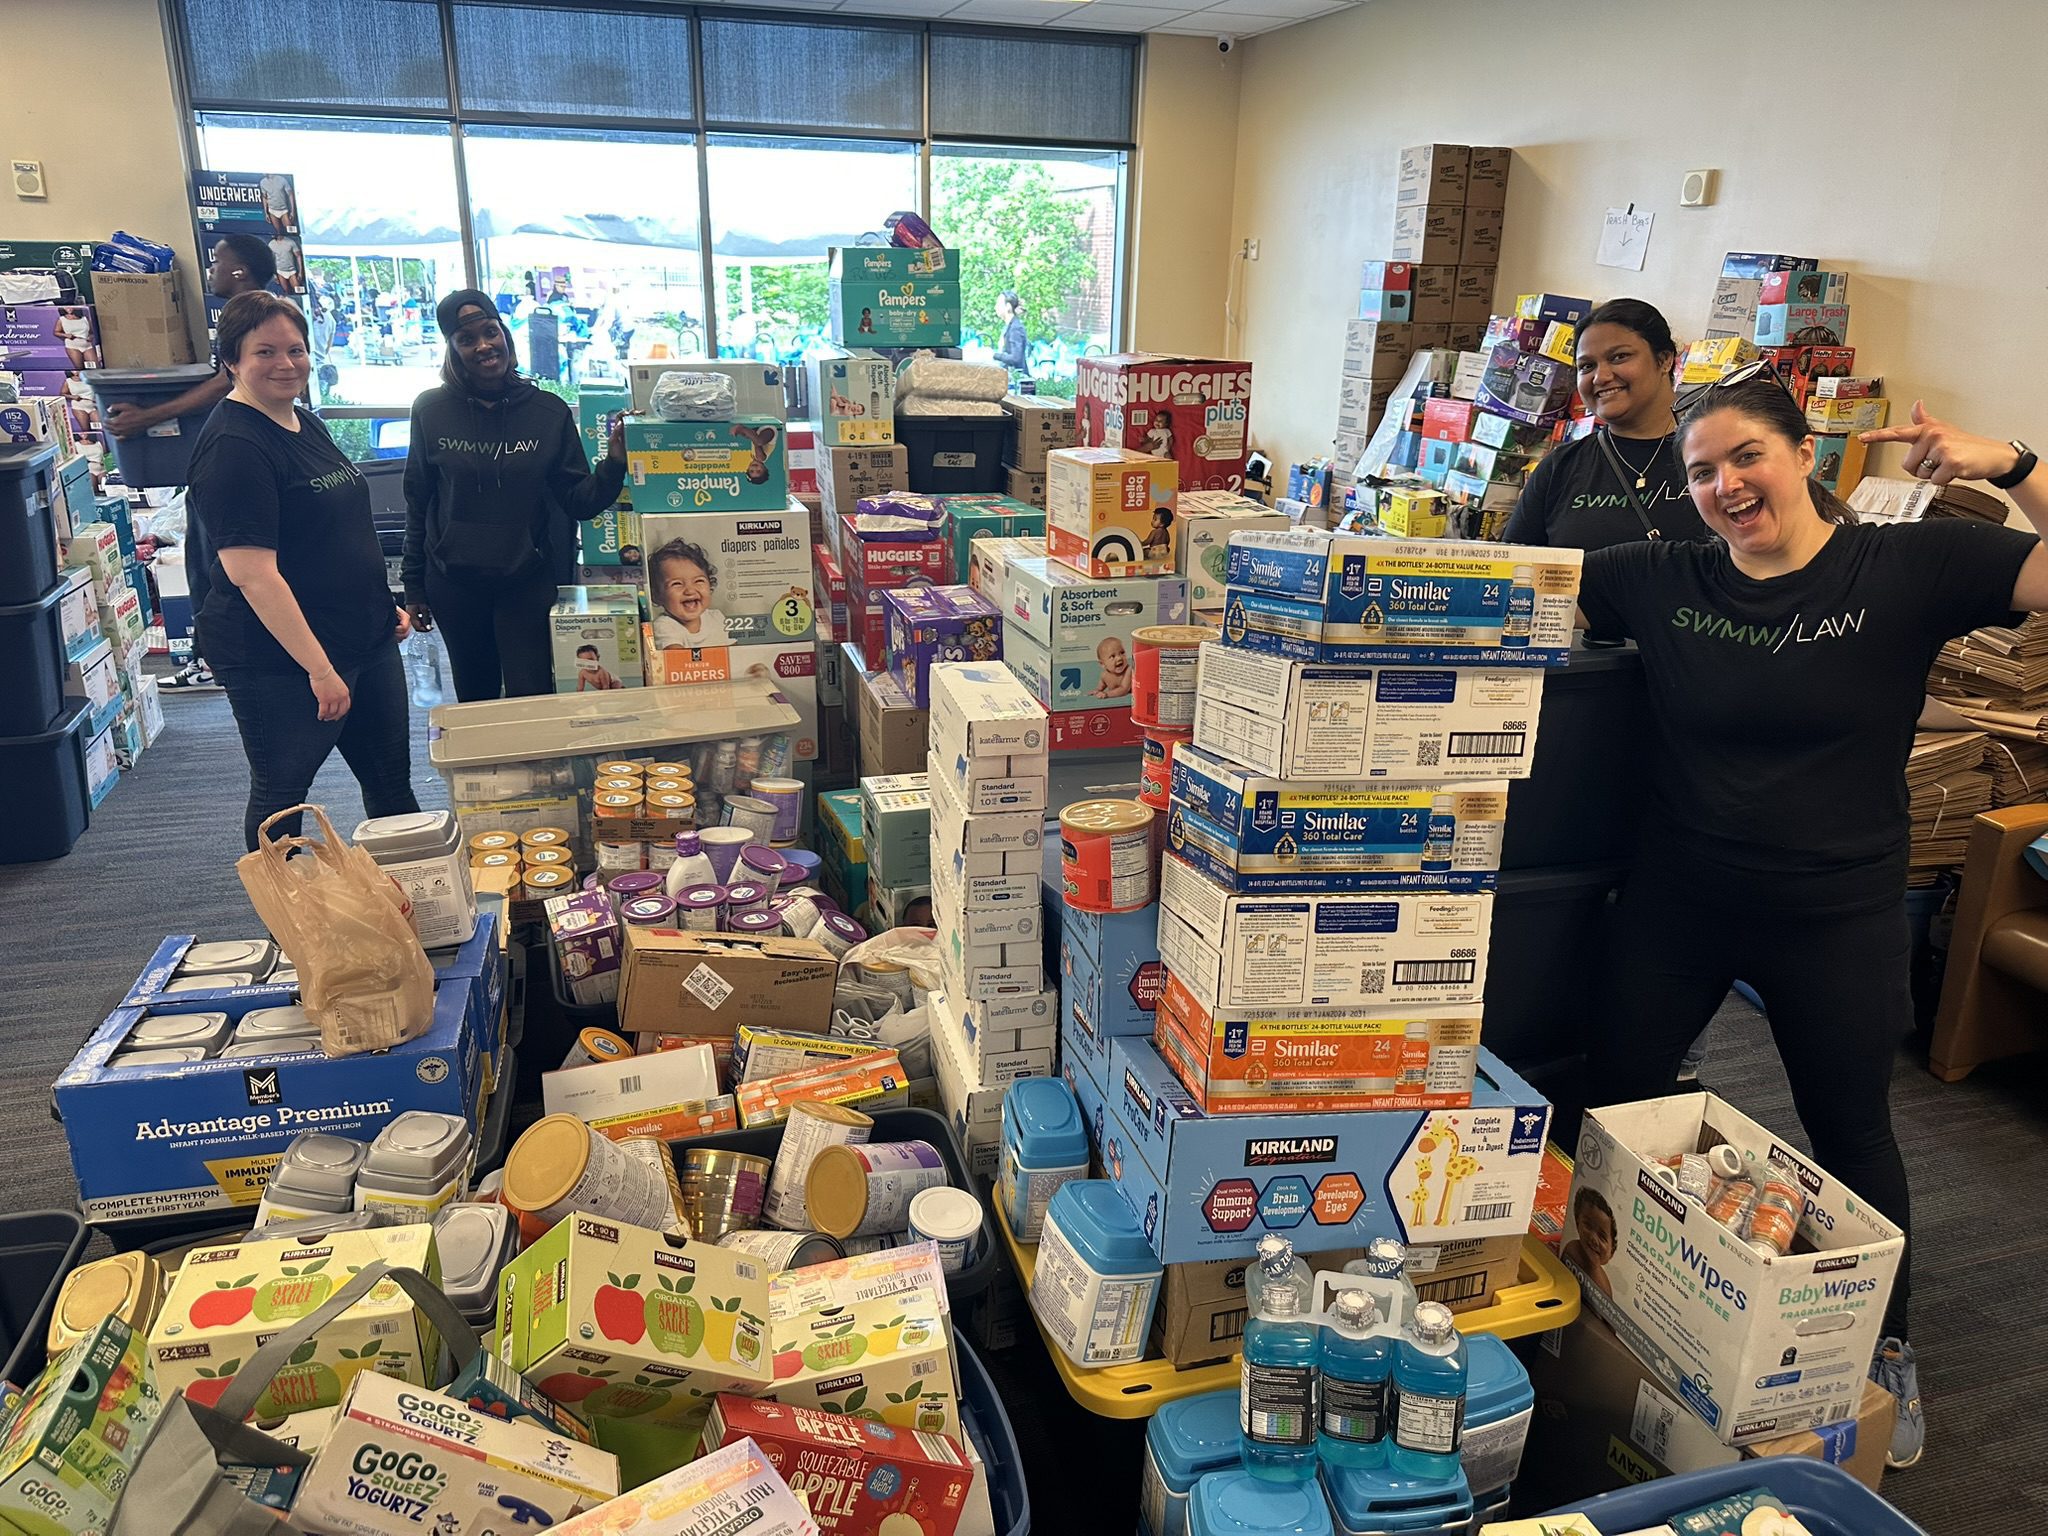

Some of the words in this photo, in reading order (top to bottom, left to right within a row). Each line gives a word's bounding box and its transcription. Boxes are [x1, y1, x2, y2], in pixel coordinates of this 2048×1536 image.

[199, 186, 261, 202] UNDERWEAR
[864, 257, 892, 269] Pampers
[879, 289, 926, 308] Pampers
[1718, 293, 1738, 304] GLAD
[1789, 305, 1817, 318] Large
[1821, 305, 1846, 318] Trash
[1128, 372, 1251, 403] HUGGIES
[1478, 391, 1489, 403] 90
[1812, 400, 1826, 408] GLAD
[1838, 401, 1853, 410] GLAD
[5, 412, 22, 420] 1152
[1206, 399, 1245, 426] plus
[438, 437, 539, 460] SWMW/LAW
[684, 462, 730, 471] swaddlers
[677, 474, 741, 497] Pampers
[1125, 476, 1136, 507] hello
[1136, 475, 1146, 507] bello
[739, 522, 780, 530] KIRKLAND
[98, 530, 116, 549] HUGGIES
[720, 539, 757, 554] diapers
[764, 537, 800, 552] pañales
[867, 550, 923, 563] HUGGIES
[1250, 558, 1283, 578] Similac
[1426, 562, 1454, 570] 24-BOTTLE
[1060, 588, 1117, 601] Absorbent
[1178, 583, 1186, 597] 1
[1390, 579, 1451, 600] Similac
[1484, 584, 1499, 597] 24
[116, 595, 137, 619] HUGGIES
[785, 600, 798, 616] 3
[1060, 602, 1069, 611] &
[1070, 601, 1094, 611] Soft
[1389, 602, 1405, 611] 360
[1408, 603, 1428, 611] Total
[1430, 603, 1447, 611] Care
[555, 617, 589, 625] Absorbent
[724, 618, 754, 631] 222
[1060, 612, 1101, 624] Diapers
[1671, 606, 1866, 654] SWMW/LAW
[779, 656, 802, 665] SAVE
[671, 669, 725, 682] DIAPERS
[780, 665, 800, 676] $800
[1502, 721, 1527, 730] 68685
[980, 734, 1018, 745] katefarms
[982, 783, 1015, 791] Standard
[1224, 792, 1236, 811] 24
[1304, 810, 1367, 830] Similac
[1401, 814, 1418, 826] 24
[980, 834, 1017, 844] katefarms
[1302, 832, 1320, 841] 360
[1322, 832, 1341, 841] Total
[1343, 832, 1362, 841] Care
[973, 879, 1007, 887] Standard
[1450, 949, 1476, 958] 68686
[781, 966, 824, 978] Easy-Open
[774, 976, 810, 986] Reclosable
[1274, 1040, 1338, 1057] Similac
[1374, 1040, 1391, 1052] 24
[996, 1059, 1028, 1068] Standard
[1123, 1092, 1149, 1142] ProCare
[1474, 1117, 1501, 1125] Complete
[136, 1112, 271, 1141] Advantage
[626, 1122, 663, 1136] Similac
[169, 1139, 198, 1149] INFANT
[200, 1136, 237, 1145] FORMULA
[239, 1130, 285, 1142] MILK-BASED
[286, 1126, 319, 1136] POWDER
[319, 1124, 341, 1132] WITH
[1250, 1139, 1334, 1155] KIRKLAND
[1461, 1144, 1476, 1153] Easy
[1486, 1144, 1504, 1153] Digest
[1249, 1153, 1333, 1166] Signature
[244, 1178, 255, 1187] &
[89, 1198, 161, 1211] COMPLETE
[163, 1189, 220, 1202] NUTRITION
[1272, 1193, 1299, 1204] Brain
[1317, 1190, 1358, 1201] Developing
[1640, 1173, 1685, 1215] KIRKLAND
[1213, 1196, 1253, 1207] Immune
[1325, 1202, 1347, 1213] Eyes
[105, 1210, 124, 1218] FOR
[126, 1206, 156, 1216] BABY'S
[157, 1203, 178, 1212] FIRST
[180, 1200, 206, 1210] YEAR
[1211, 1209, 1251, 1221] Support
[1262, 1205, 1306, 1216] Development
[1632, 1196, 1748, 1311] BabyWipes
[656, 1253, 694, 1268] KIRKLAND
[1816, 1258, 1858, 1269] KIRKLAND
[271, 1275, 322, 1286] ORGANIC
[878, 1273, 904, 1283] POUCHES
[910, 1272, 932, 1285] FRUIT
[1630, 1227, 1696, 1293] FRAGRANCE
[1698, 1289, 1730, 1323] FREE
[900, 1279, 908, 1287] &
[272, 1284, 313, 1297] APPLE
[856, 1283, 899, 1301] VEGETABLE
[1779, 1276, 1877, 1305] BabyWipes
[271, 1293, 312, 1306] SAUCE
[654, 1293, 696, 1306] ORGANIC
[658, 1302, 689, 1322] APPLE
[1780, 1305, 1841, 1320] FRAGRANCE
[1842, 1300, 1867, 1312] FREE
[658, 1316, 690, 1335] SAUCE
[101, 1342, 120, 1370] FRUIT
[818, 1376, 861, 1391] KIRKLAND
[792, 1407, 856, 1426] SQUEEZABLE
[399, 1408, 477, 1445] YOGURTZ
[795, 1417, 865, 1443] APPLE
[1735, 1419, 1776, 1435] KIRKLAND
[813, 1434, 858, 1446] CINNAMON
[352, 1443, 438, 1482] GoGo
[742, 1461, 760, 1473] 12
[797, 1451, 869, 1480] SQUEEZABLE
[876, 1469, 894, 1484] Fruit
[477, 1482, 499, 1493] FAMILY
[477, 1489, 495, 1497] SIZE!
[870, 1481, 893, 1495] Blend
[948, 1483, 960, 1497] 12
[19, 1478, 68, 1513] GoGo
[347, 1475, 431, 1523] YOGURTZ
[692, 1490, 731, 1514] POUCHES
[85, 1509, 98, 1522] Try
